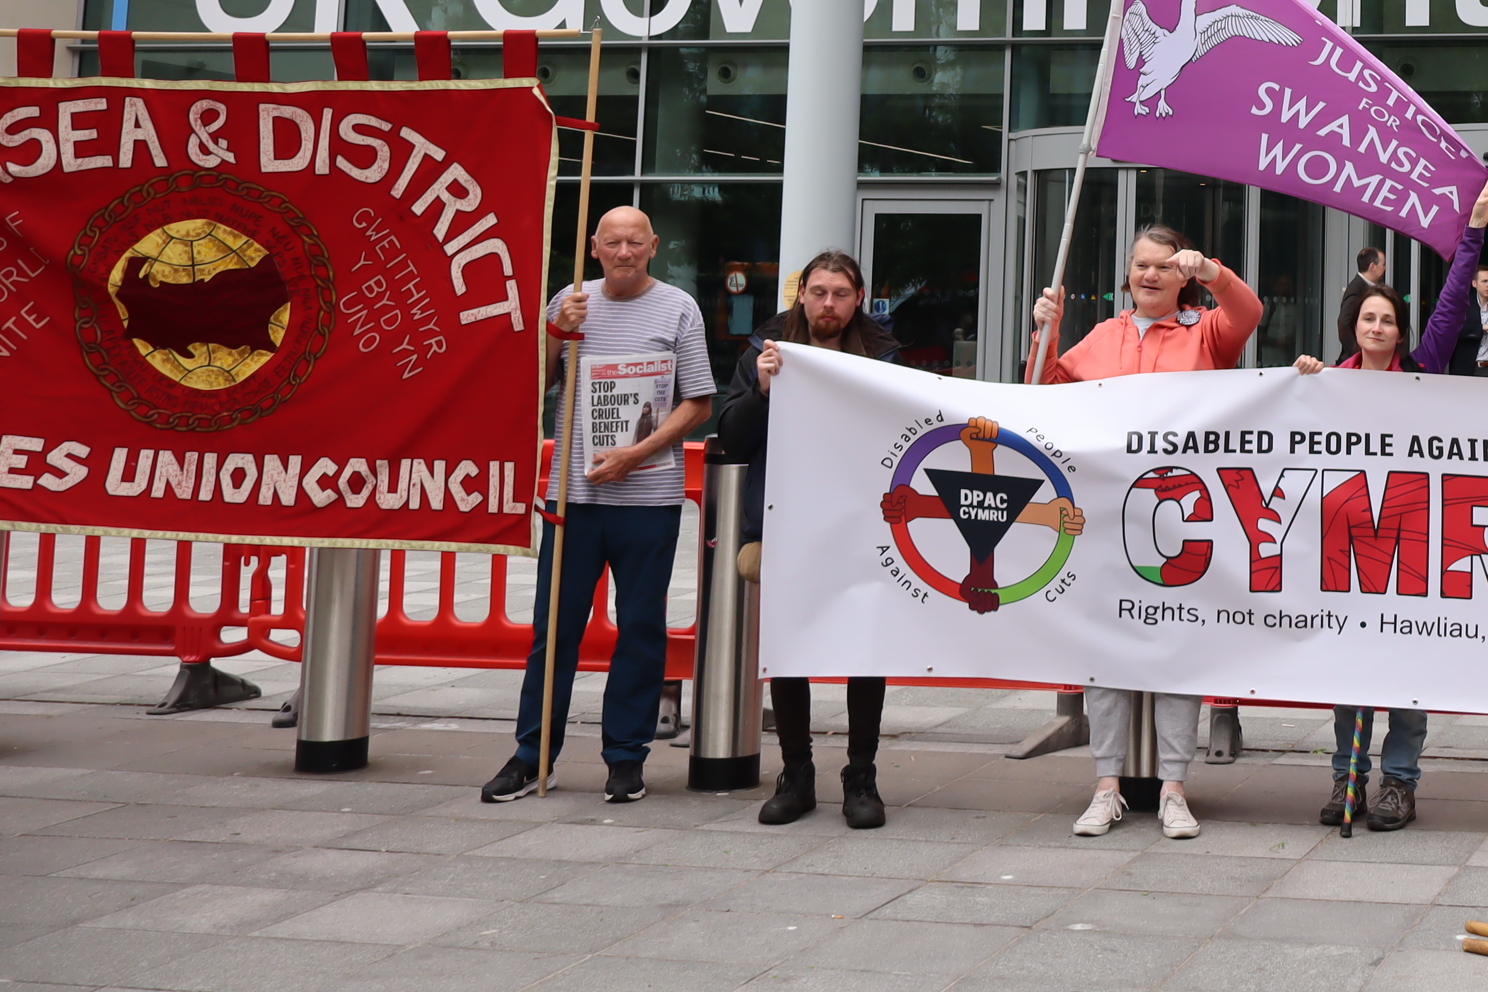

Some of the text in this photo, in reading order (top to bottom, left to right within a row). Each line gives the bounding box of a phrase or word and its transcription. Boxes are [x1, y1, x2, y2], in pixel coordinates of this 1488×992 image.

[1308, 36, 1457, 160] JUSTICE
[1358, 97, 1401, 133] FOR
[1250, 81, 1461, 214] SWANSEA
[1258, 132, 1440, 229] WOMEN
[0, 96, 169, 184] SEA
[187, 98, 236, 169] &
[258, 103, 525, 333] DISTRICT
[352, 207, 448, 360] GWEITHWYR
[339, 291, 380, 353] UNO
[350, 251, 424, 380] Y BYD YN
[591, 381, 616, 394] STOP
[617, 359, 673, 375] Socialist
[591, 392, 640, 407] LABOUR'S
[591, 408, 622, 421] CRUEL
[591, 420, 630, 434] BENEFIT
[591, 434, 617, 447] CUTS
[880, 409, 1078, 474] Disabled People
[1126, 430, 1274, 456] DISABLED
[1289, 430, 1395, 457] PEOPLE
[959, 488, 1009, 509] DPAC
[959, 507, 1008, 523] CYMRU
[876, 544, 1077, 604] Against Cuts
[1118, 598, 1207, 626] Rights,
[1216, 608, 1255, 627] not
[1263, 608, 1349, 635] charity
[1379, 613, 1487, 644] Hawliau,
